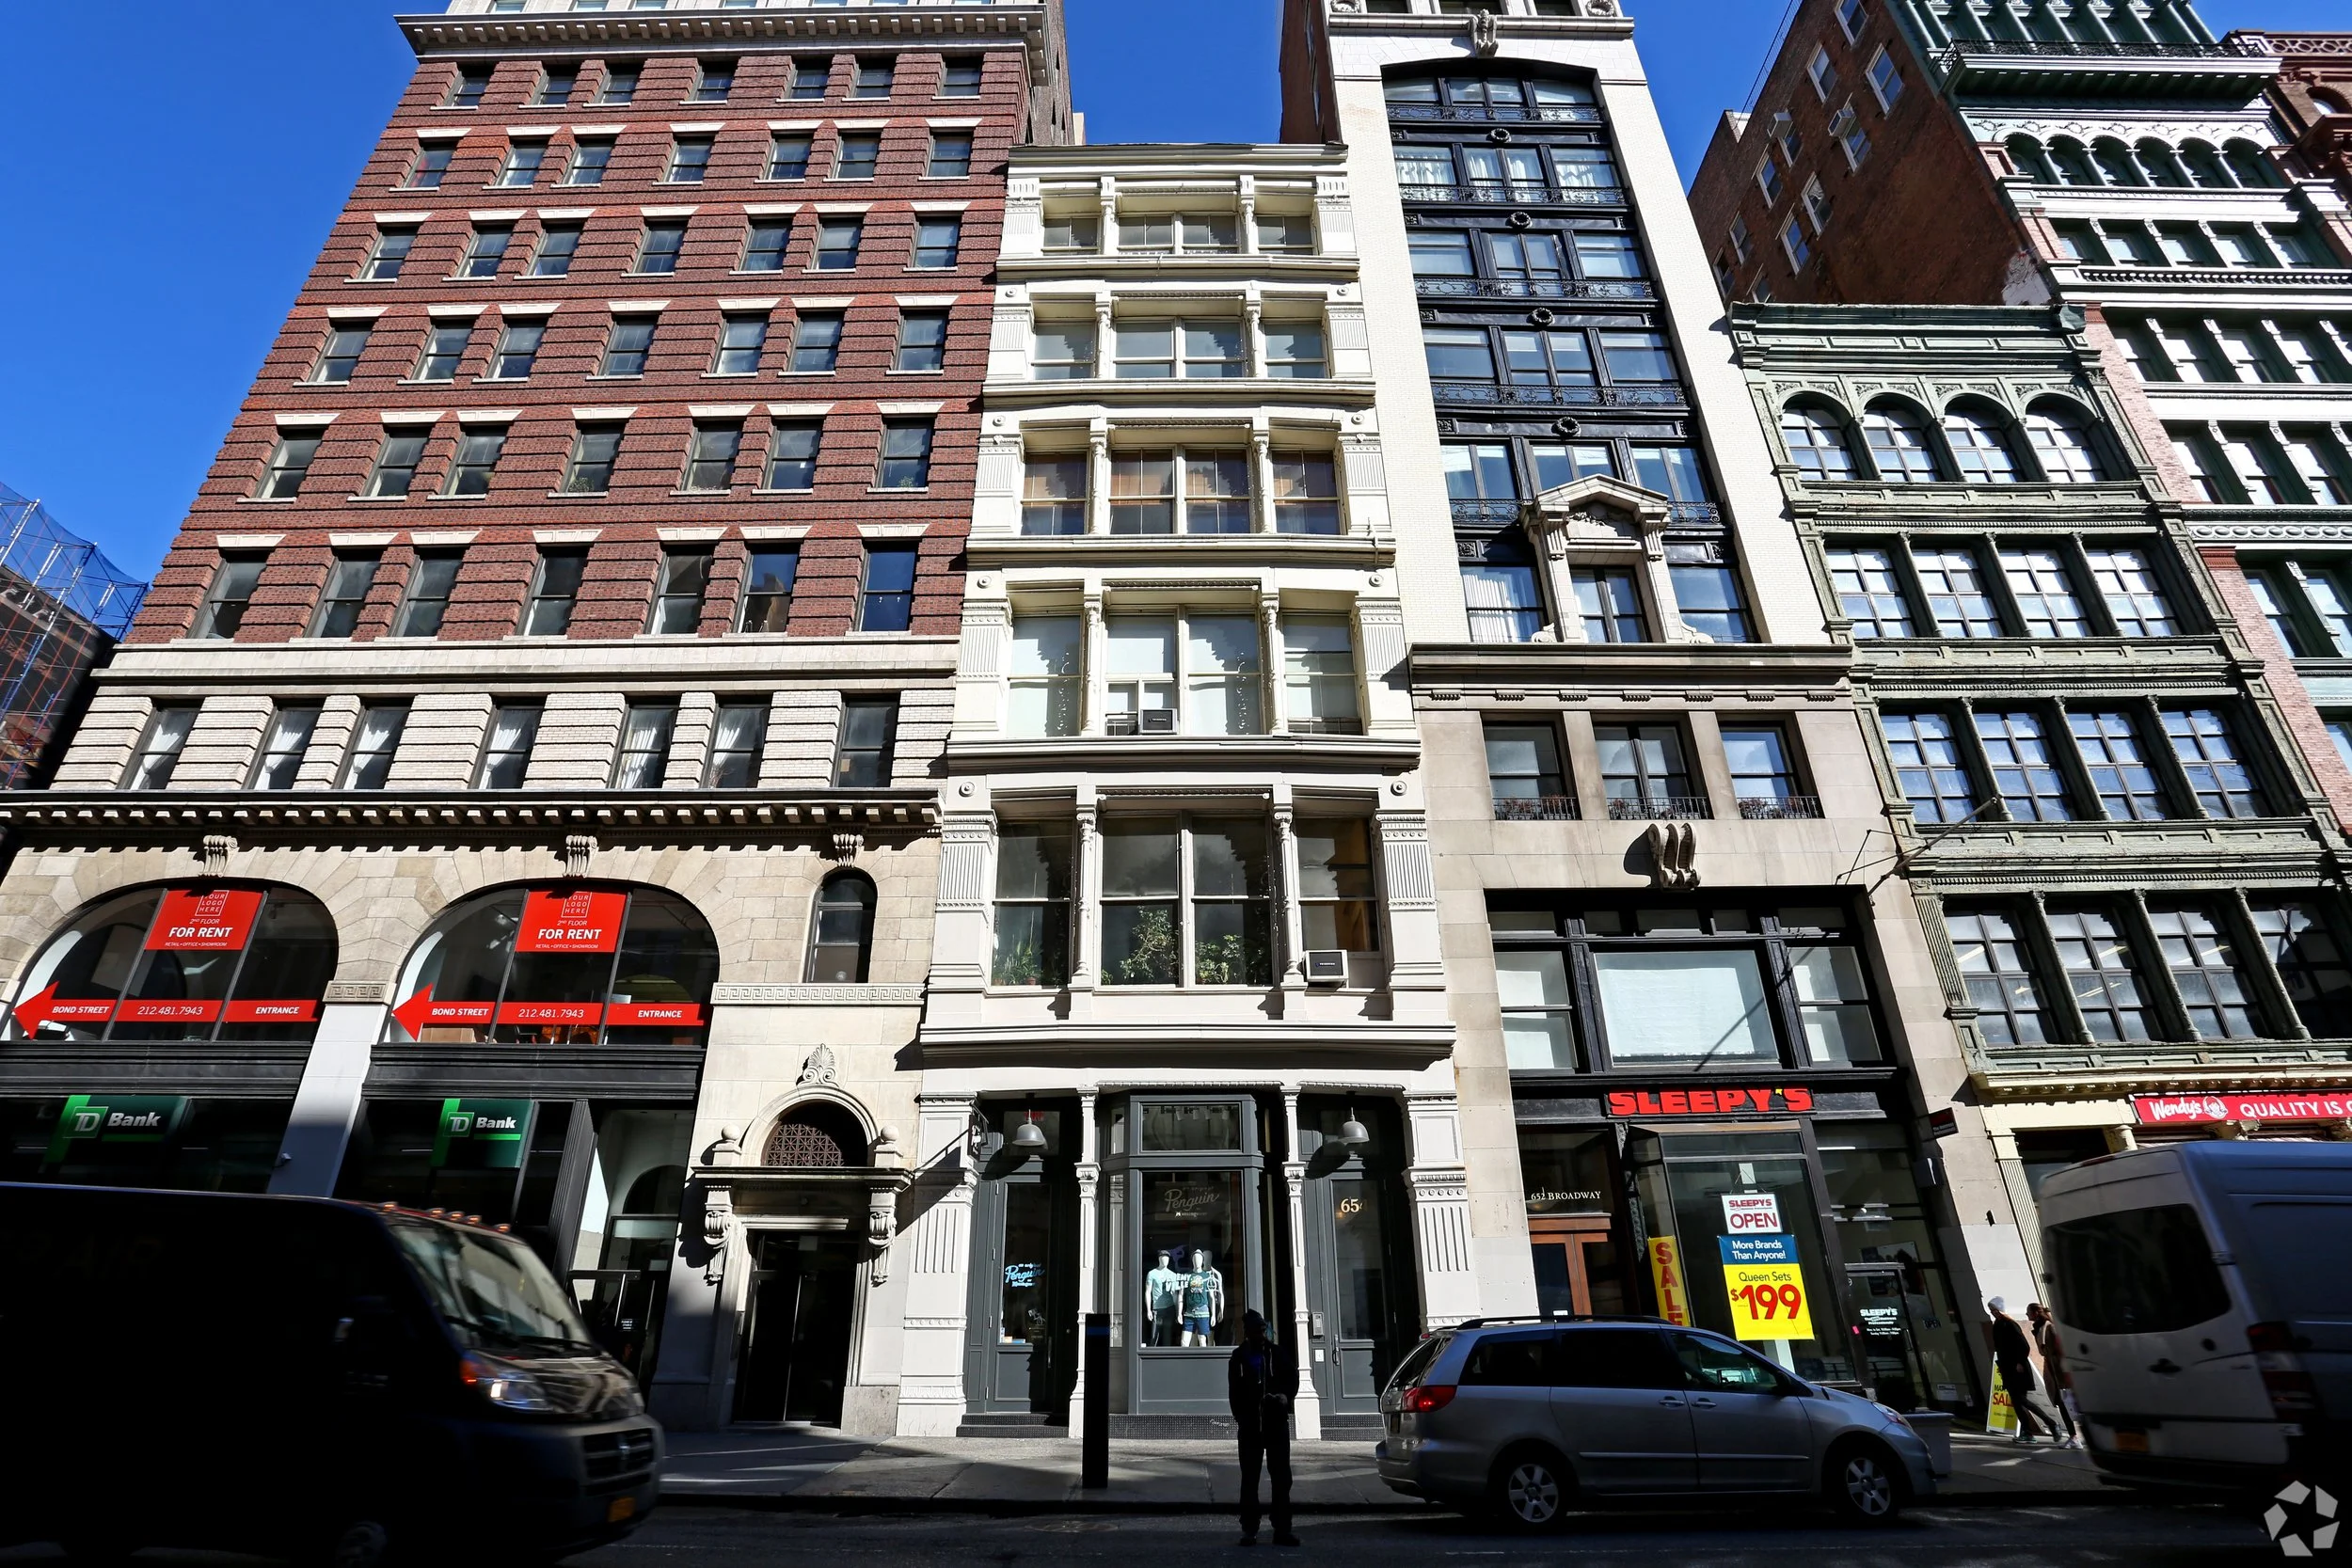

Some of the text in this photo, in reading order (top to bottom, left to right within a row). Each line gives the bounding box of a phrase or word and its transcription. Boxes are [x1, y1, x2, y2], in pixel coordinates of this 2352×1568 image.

[168, 927, 233, 938] FOR RENT
[537, 928, 602, 940] FOR RENT
[52, 1006, 110, 1014] BOND STREET
[137, 1006, 204, 1015] 212.481.7943
[255, 1006, 300, 1015] ENTRANCE
[431, 1008, 489, 1017] BOND STREET
[517, 1008, 584, 1019] 212.481.7943
[637, 1009, 683, 1018] ENTRANCE
[1608, 1088, 1812, 1117] SLEEPY'S
[2149, 1097, 2202, 1120] Wendy's
[2240, 1101, 2319, 1117] QUALITY
[2324, 1101, 2344, 1116] IS
[74, 1112, 162, 1132] TD Bank
[449, 1116, 517, 1132] TD Bank
[1165, 1189, 1219, 1212] Penguin
[1548, 1191, 1601, 1200] BROADWAY
[1730, 1212, 1778, 1229] OPEN
[1732, 1240, 1783, 1249] More Brands
[1732, 1250, 1787, 1261] Than Anyone!
[1739, 1271, 1792, 1282] Queen Sets
[1730, 1283, 1802, 1320] $199
[1992, 1392, 2013, 1408] SAL
